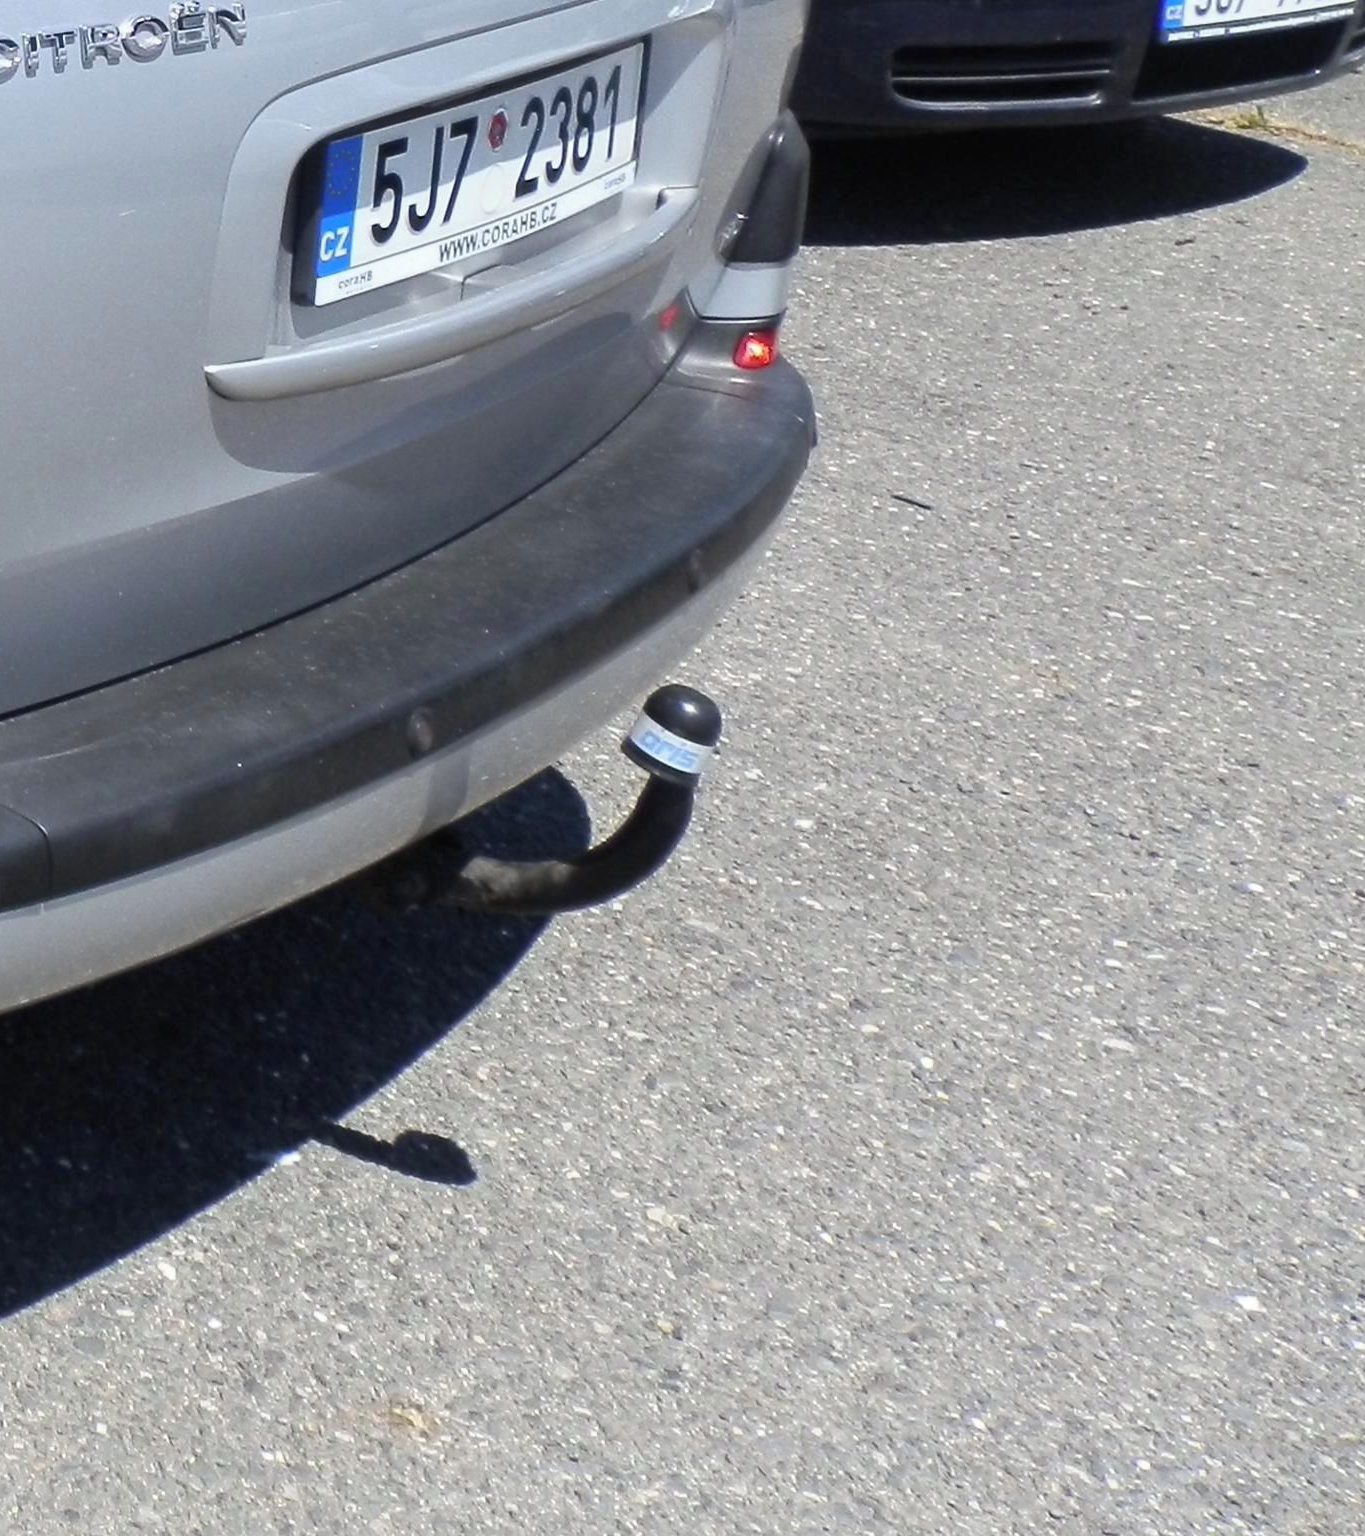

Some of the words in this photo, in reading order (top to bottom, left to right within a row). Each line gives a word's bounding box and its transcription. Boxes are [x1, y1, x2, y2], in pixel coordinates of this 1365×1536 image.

[371, 115, 479, 245] 5J7
[514, 64, 622, 199] 2381
[320, 226, 350, 262] CZ
[438, 202, 558, 263] WWW.CORAHB.CZ
